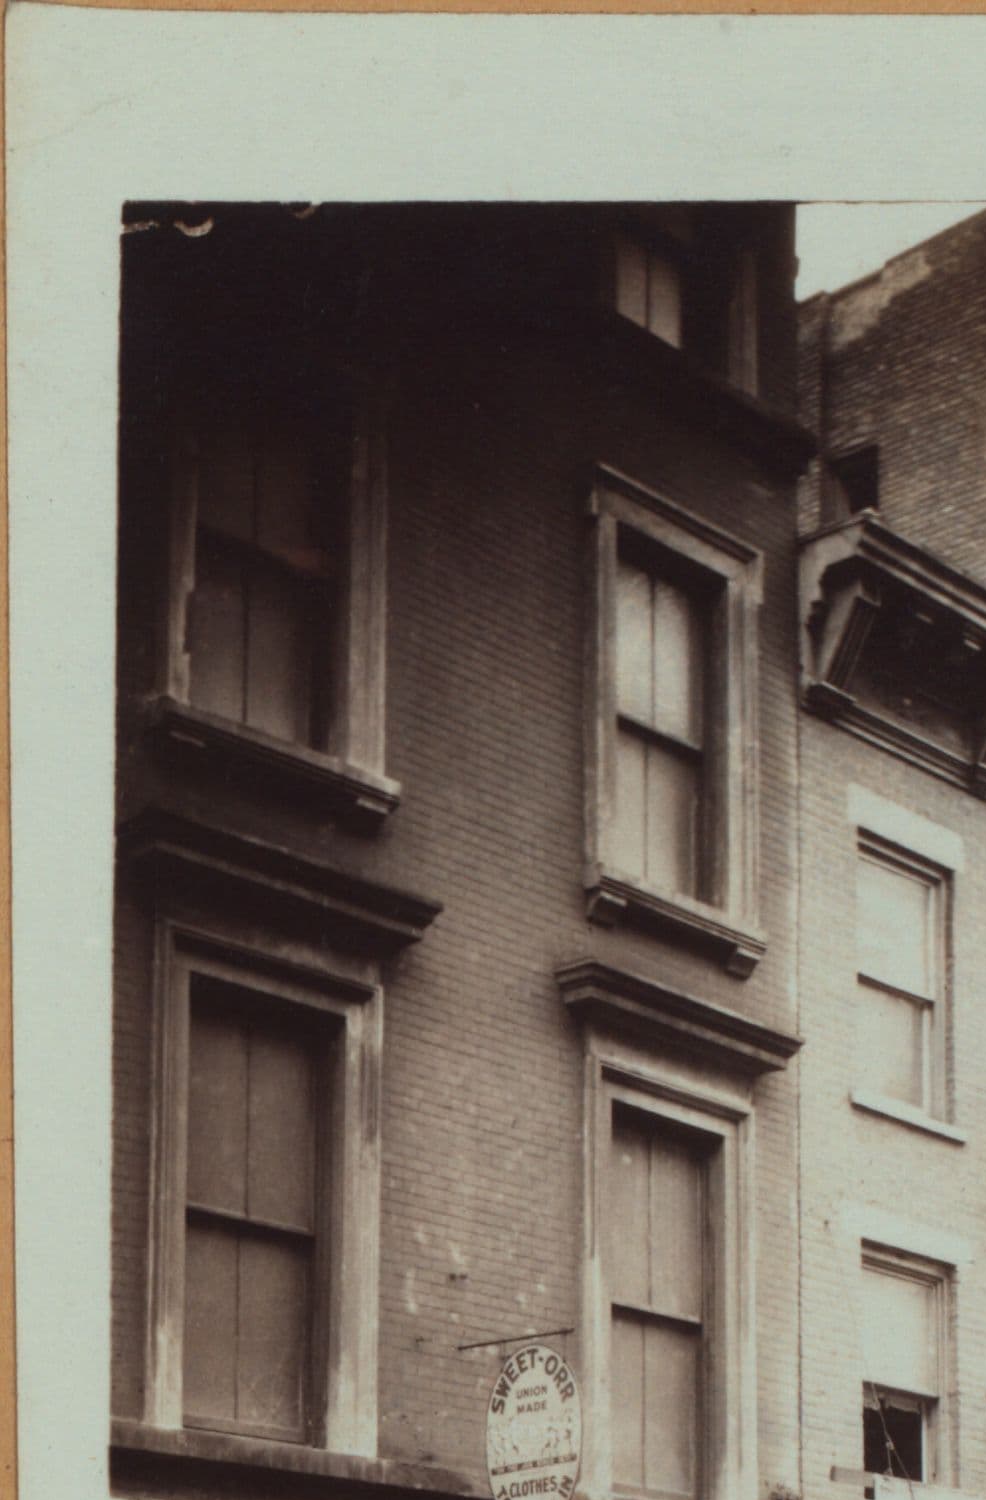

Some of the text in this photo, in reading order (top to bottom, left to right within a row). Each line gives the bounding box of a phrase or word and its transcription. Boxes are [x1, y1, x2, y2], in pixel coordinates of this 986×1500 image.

[515, 1384, 548, 1400] UNION
[516, 1399, 548, 1414] MADE
[509, 1475, 557, 1499] CLOTHES
[558, 1475, 573, 1498] IN
